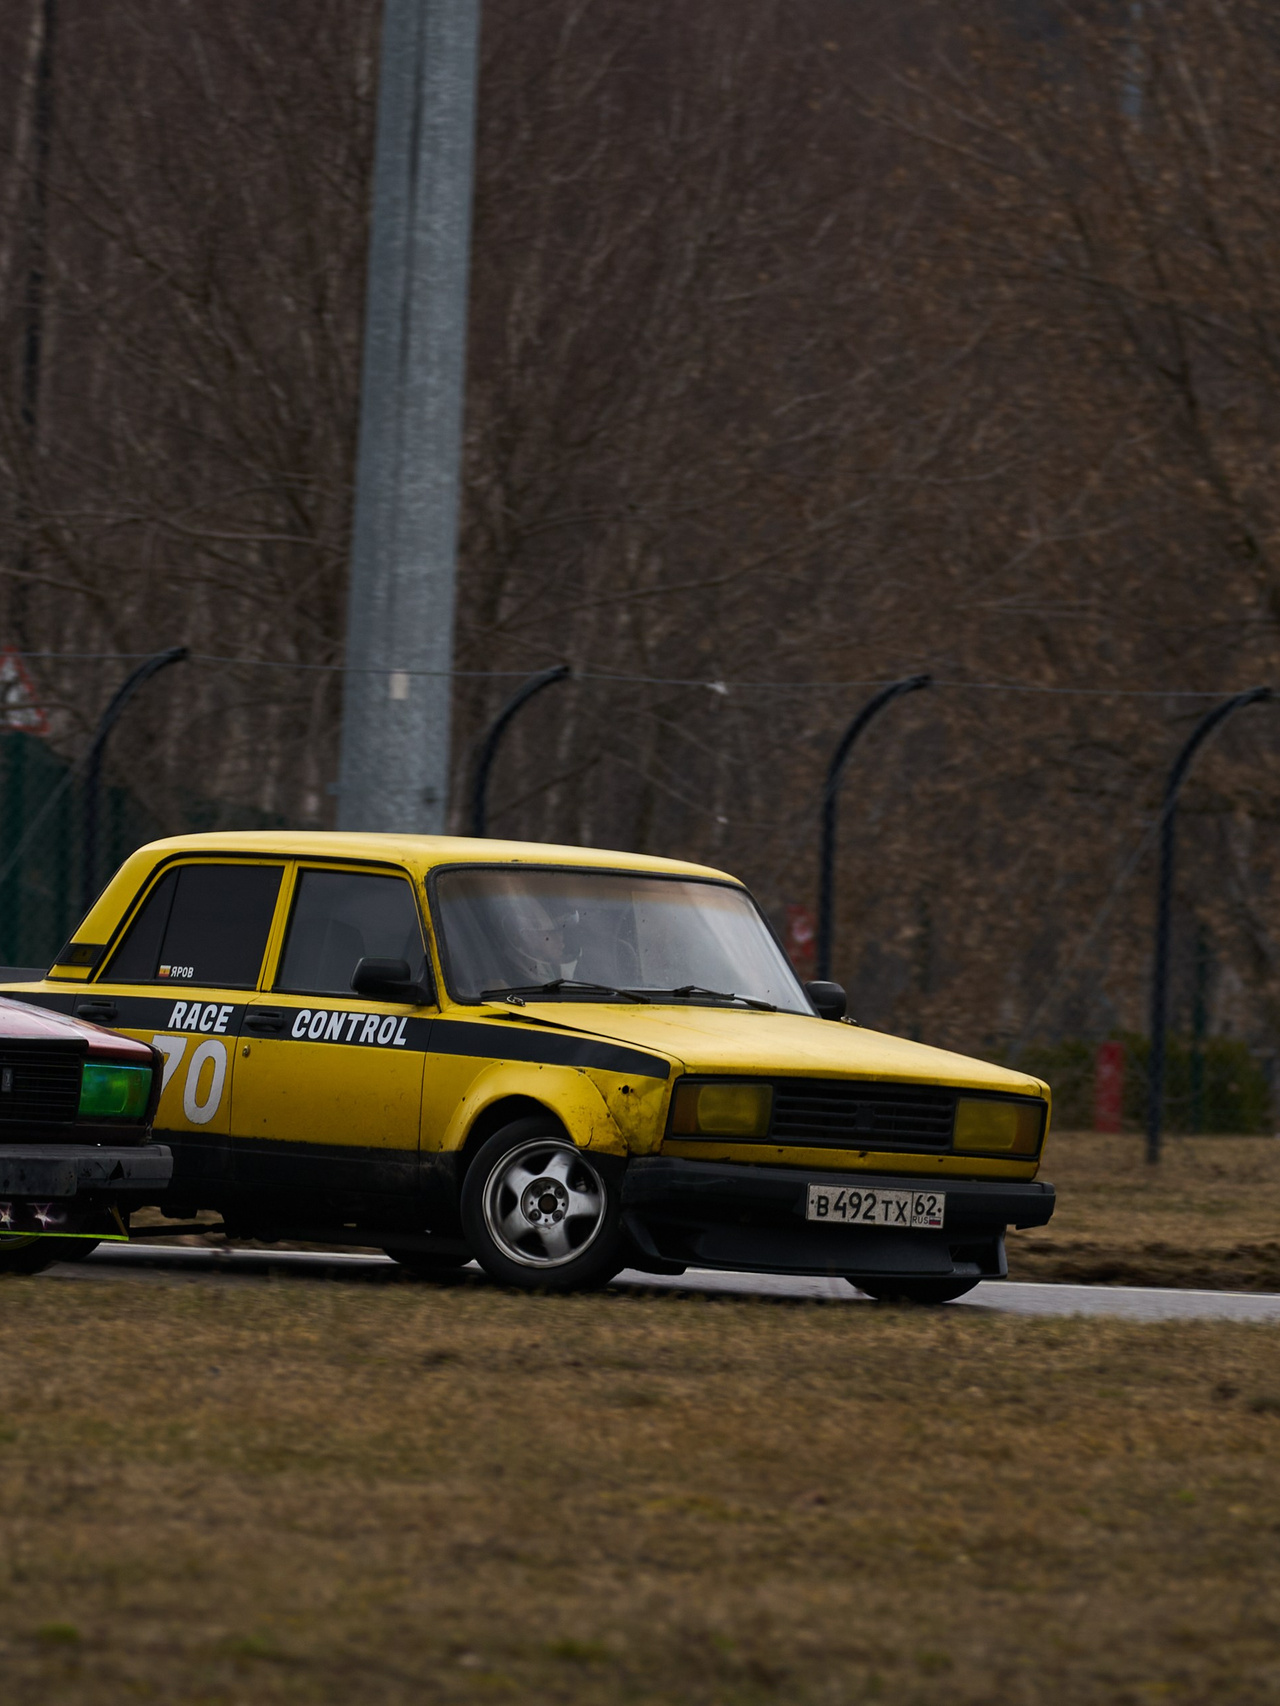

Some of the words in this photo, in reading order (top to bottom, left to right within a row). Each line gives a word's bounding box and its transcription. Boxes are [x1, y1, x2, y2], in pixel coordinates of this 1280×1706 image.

[170, 966, 194, 978] ЯРОВ
[168, 1001, 234, 1033] RACE
[291, 1009, 408, 1046] CONTROL
[151, 1034, 228, 1125] 70
[914, 1195, 937, 1216] 62
[912, 1215, 929, 1225] RUS
